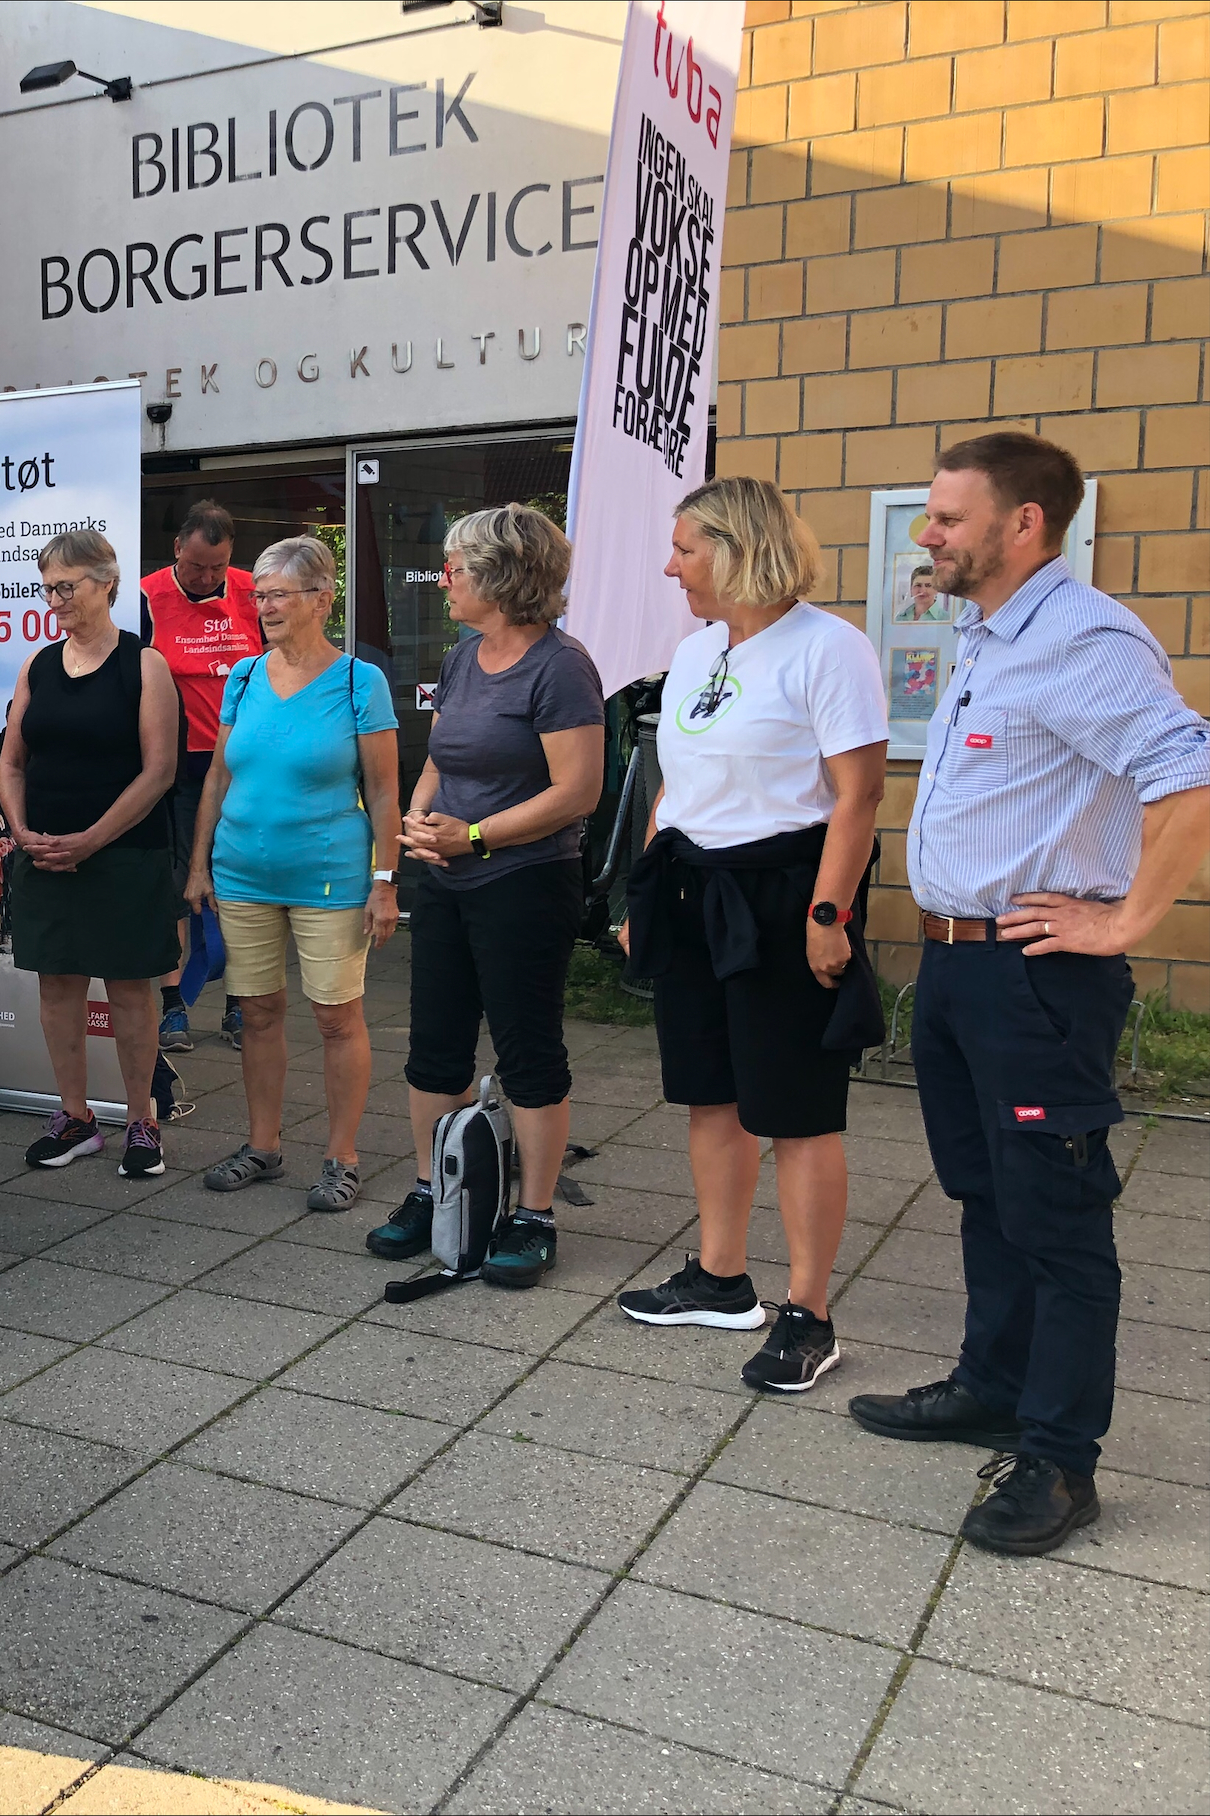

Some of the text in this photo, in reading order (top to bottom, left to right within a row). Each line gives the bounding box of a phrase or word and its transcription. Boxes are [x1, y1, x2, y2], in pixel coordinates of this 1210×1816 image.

[131, 72, 479, 199] BIBLIOTEK
[637, 112, 715, 235] INGEN SKAL
[40, 174, 605, 321] BORGERSERVICE
[635, 159, 715, 301] VOKSE
[624, 236, 708, 363] OP MED
[254, 353, 320, 389] OG
[349, 322, 588, 379] KULTUR
[20, 515, 107, 538] Danmarks
[405, 570, 443, 583] Bibliot
[22, 609, 72, 642] 00
[175, 634, 220, 644] Ensomhed
[203, 616, 234, 634] Støt
